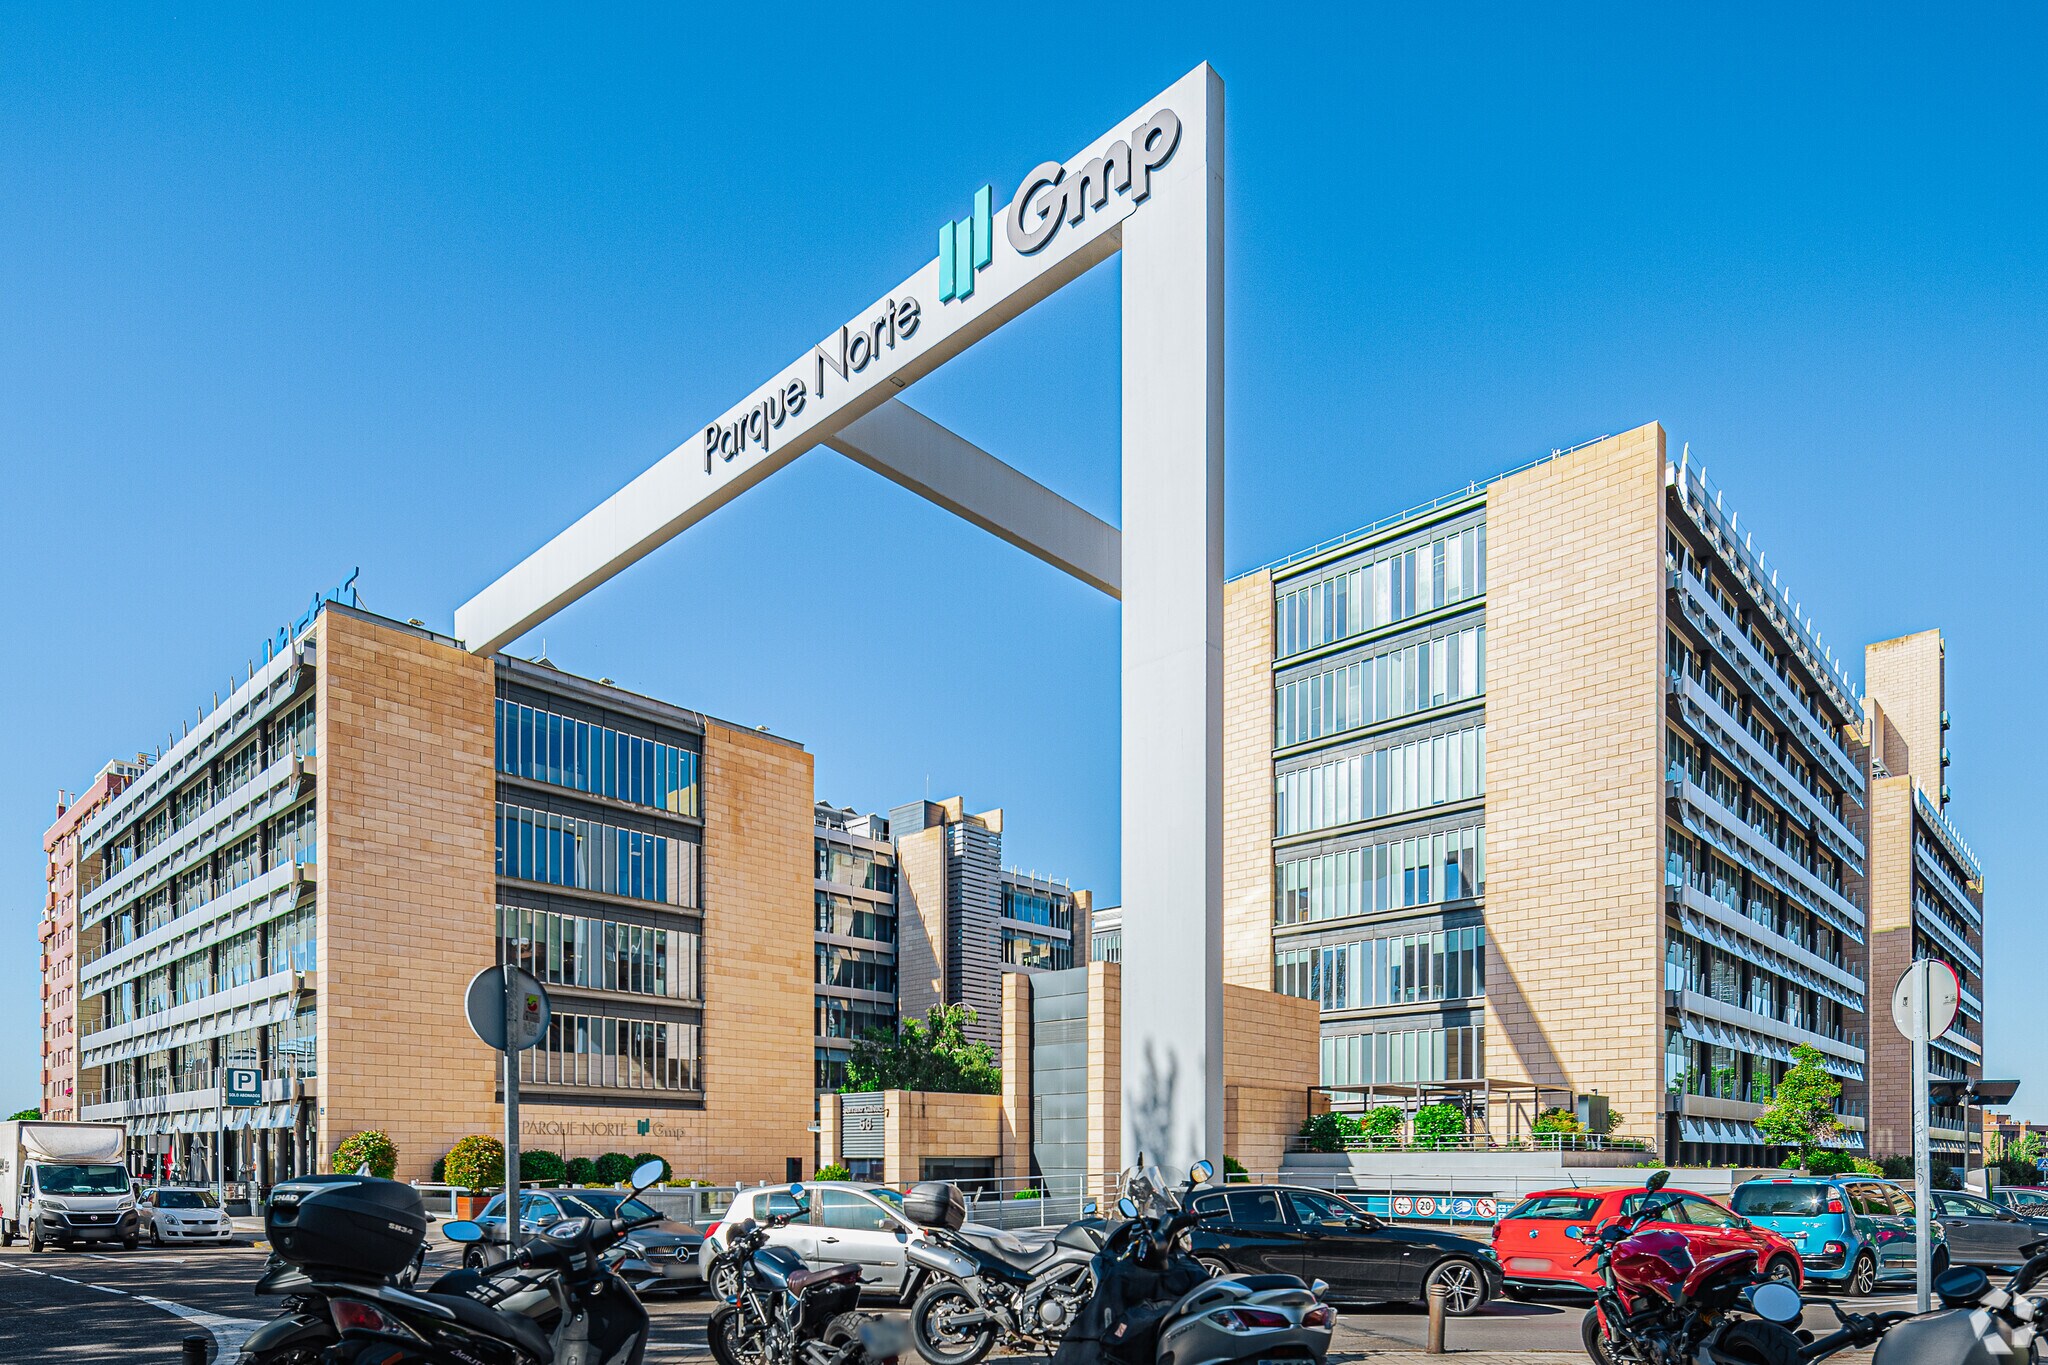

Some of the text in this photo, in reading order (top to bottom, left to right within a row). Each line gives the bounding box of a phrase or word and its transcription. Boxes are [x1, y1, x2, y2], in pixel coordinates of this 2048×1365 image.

[1006, 108, 1183, 254] Gmp
[705, 296, 921, 474] Parque Norte
[238, 1073, 252, 1089] P
[522, 1120, 628, 1136] PARQUE NORTE
[652, 1122, 686, 1141] Gmp
[273, 1194, 299, 1202] SHAD
[1420, 1201, 1431, 1211] 20
